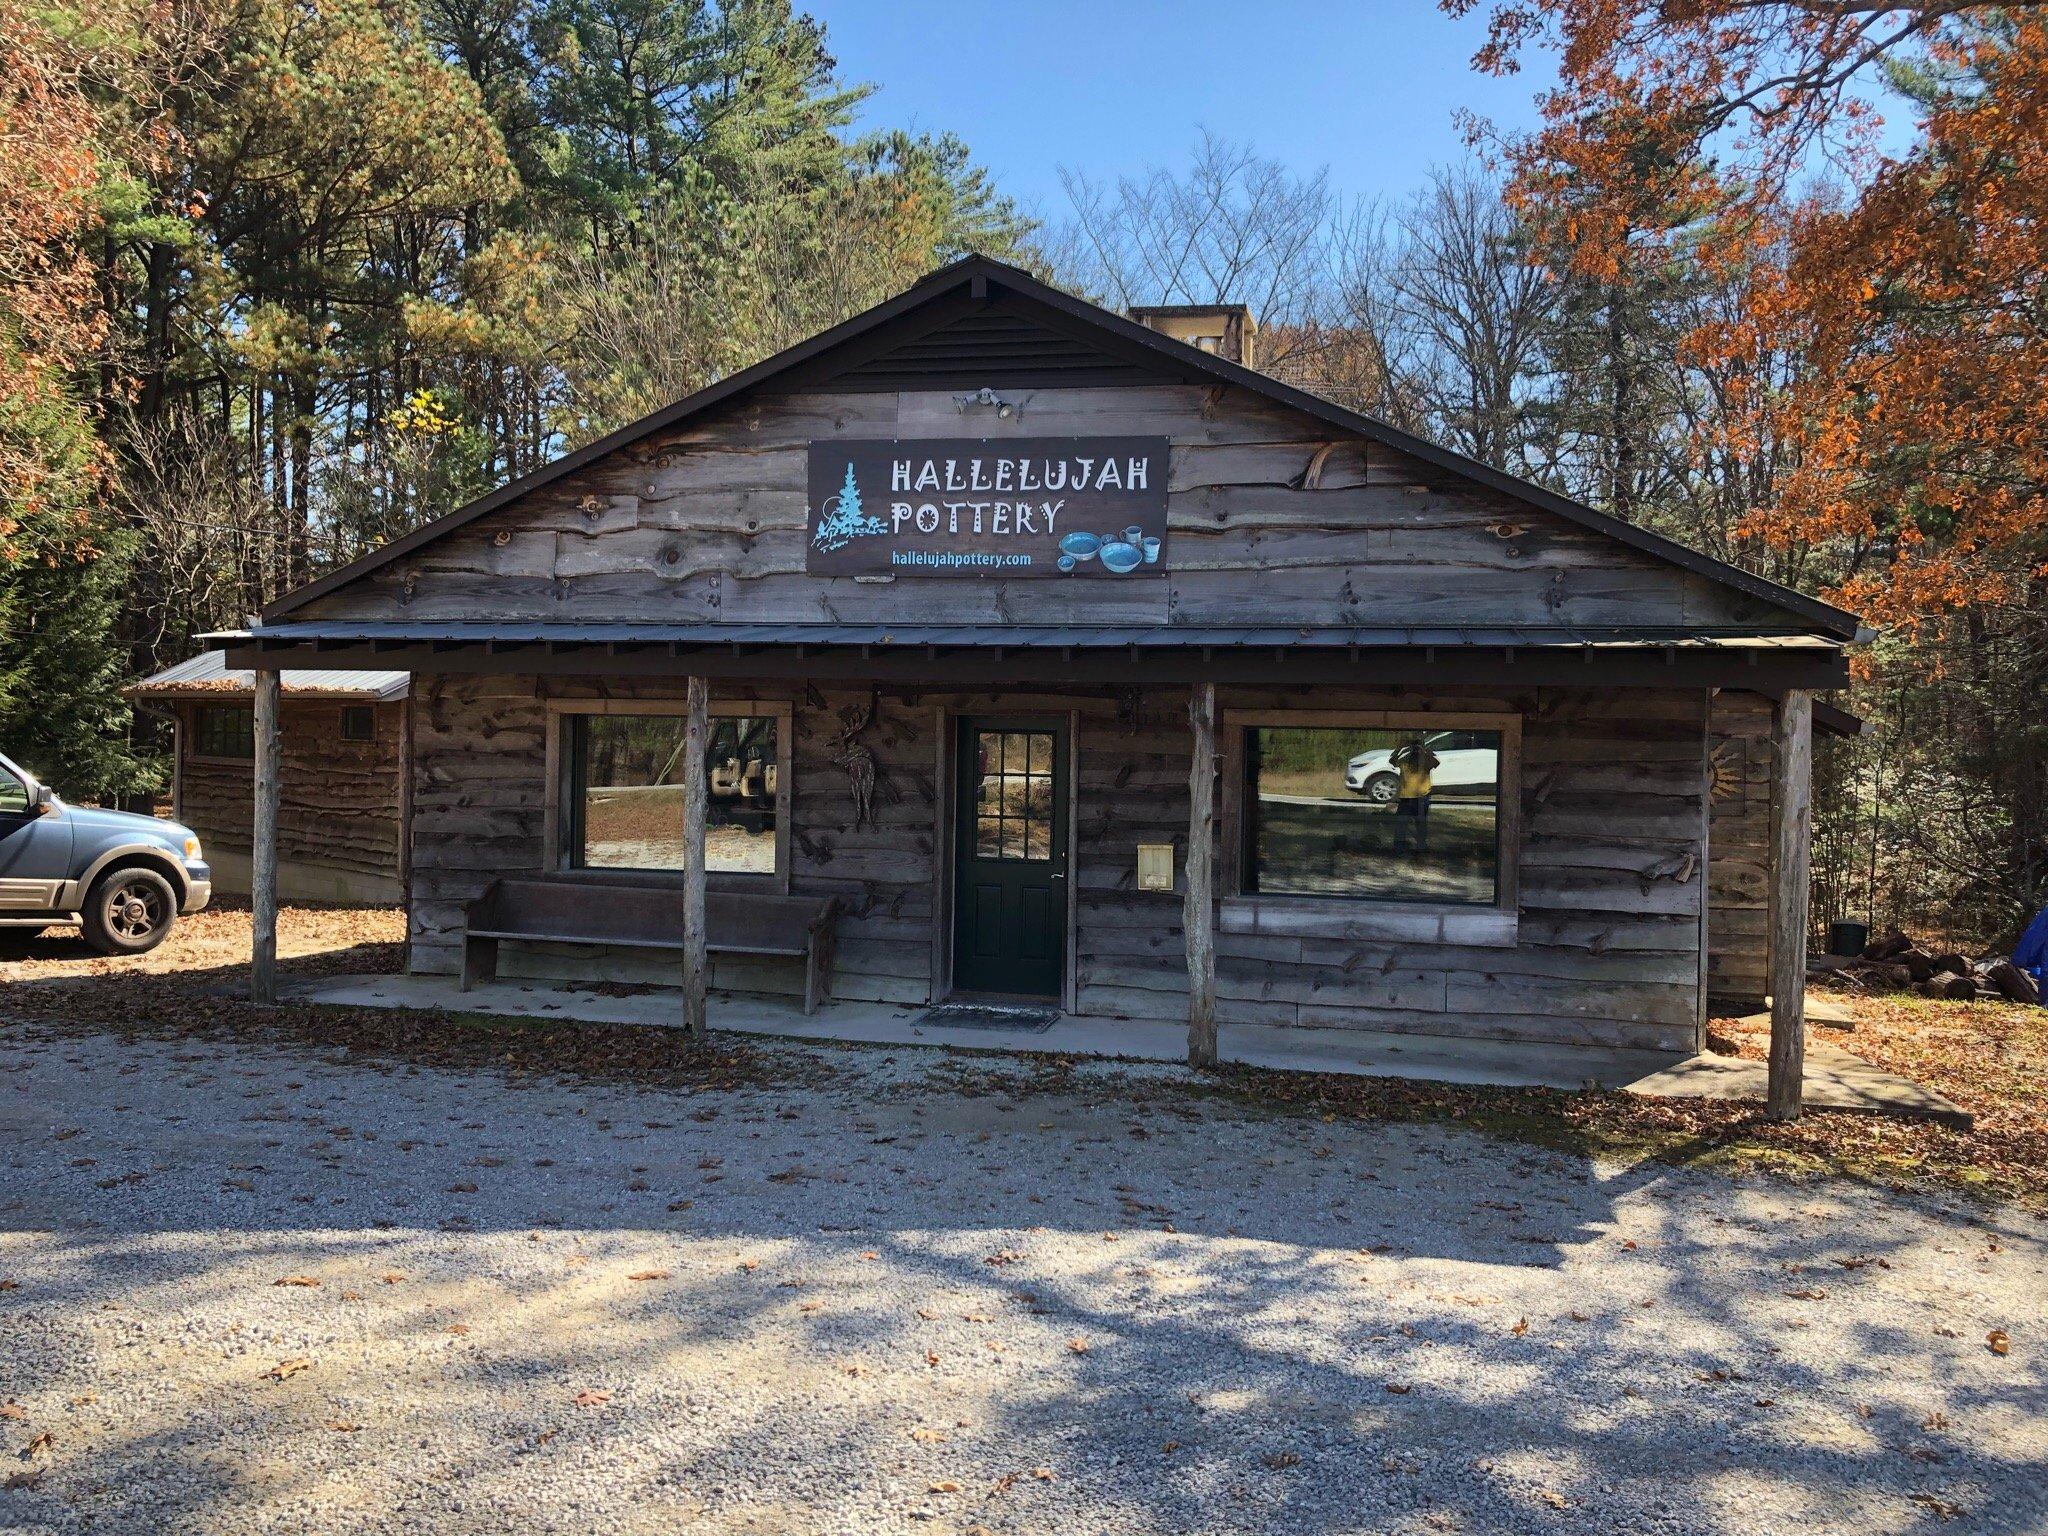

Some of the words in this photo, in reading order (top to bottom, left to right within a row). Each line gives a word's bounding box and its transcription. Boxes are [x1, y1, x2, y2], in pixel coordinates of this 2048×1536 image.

[891, 457, 1148, 492] HALLELUJAH
[891, 500, 1065, 534] POTTERY
[892, 551, 1031, 569] hallelujahpottery.com
